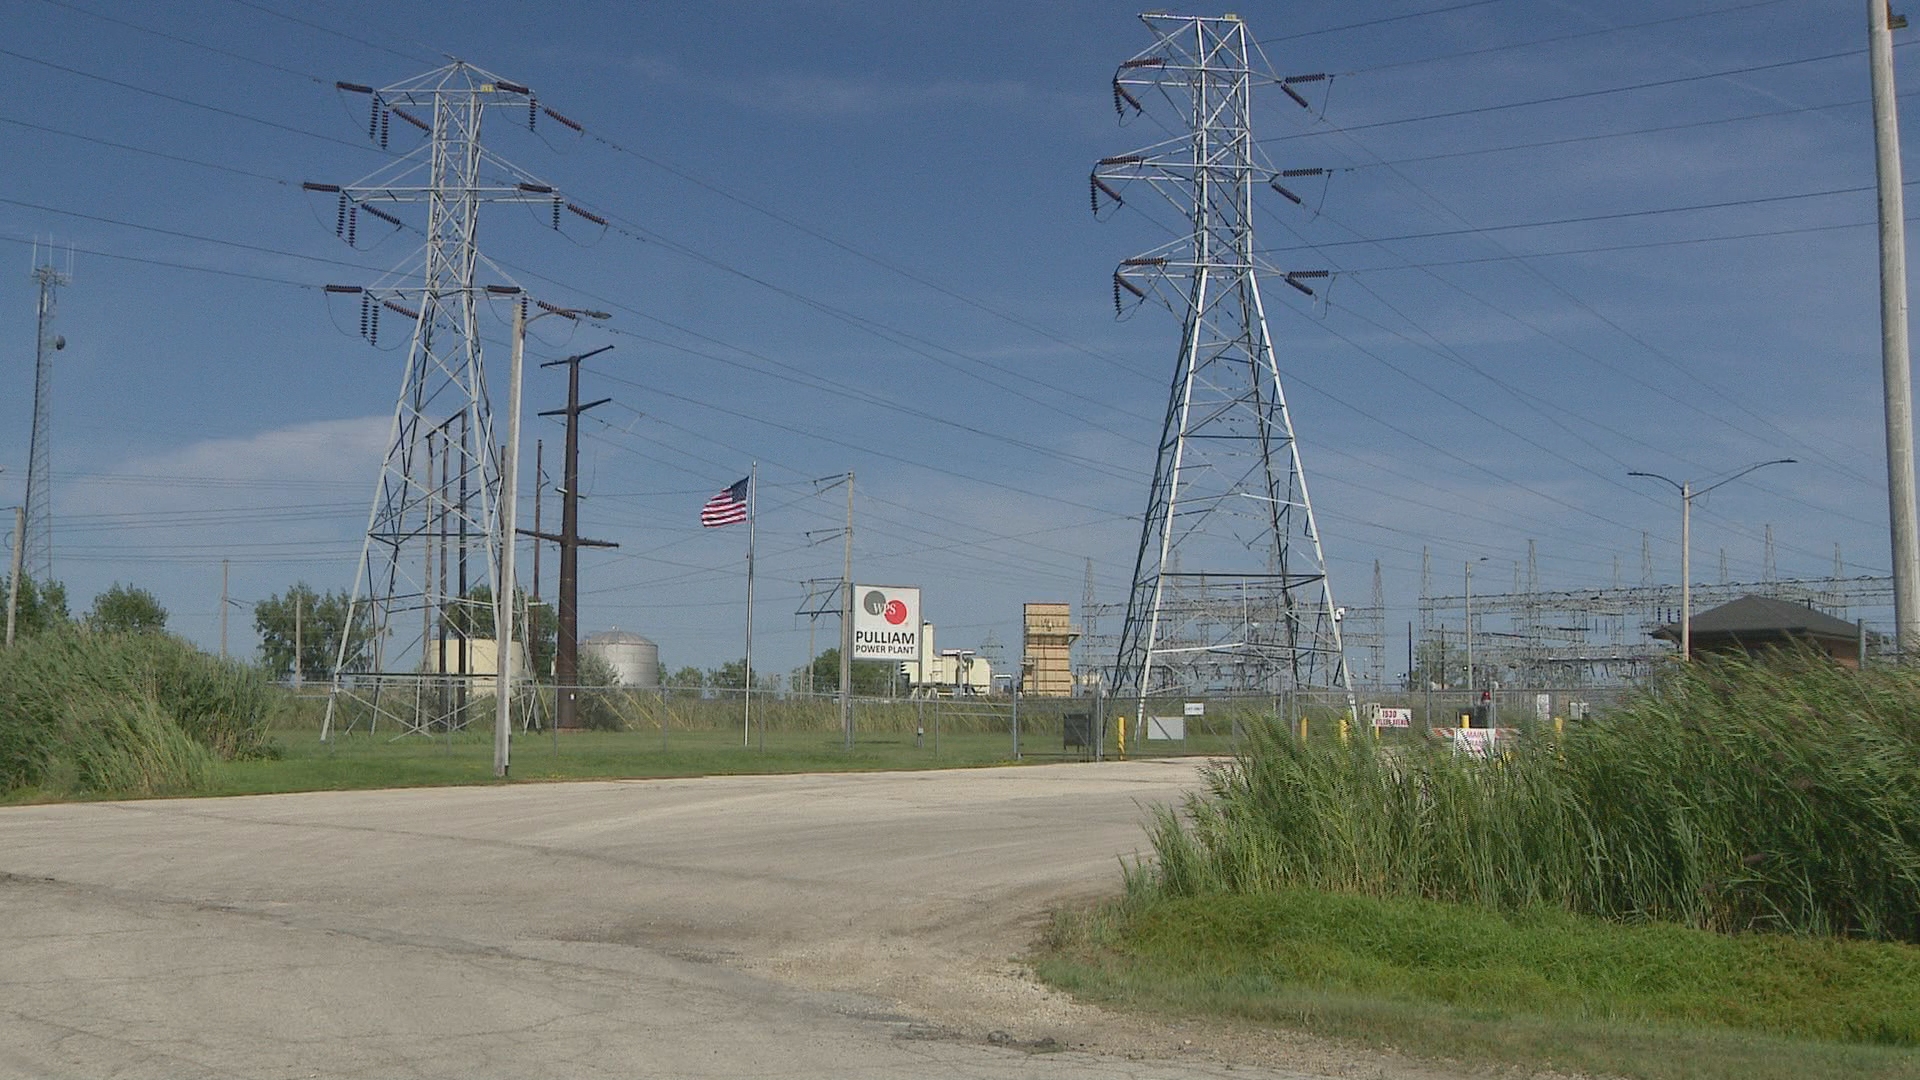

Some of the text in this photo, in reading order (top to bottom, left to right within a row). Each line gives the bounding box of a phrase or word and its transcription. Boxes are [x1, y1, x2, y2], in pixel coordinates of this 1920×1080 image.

[873, 603, 896, 615] WPS
[856, 631, 914, 644] PULLIAM
[856, 645, 914, 654] POWER PLANT
